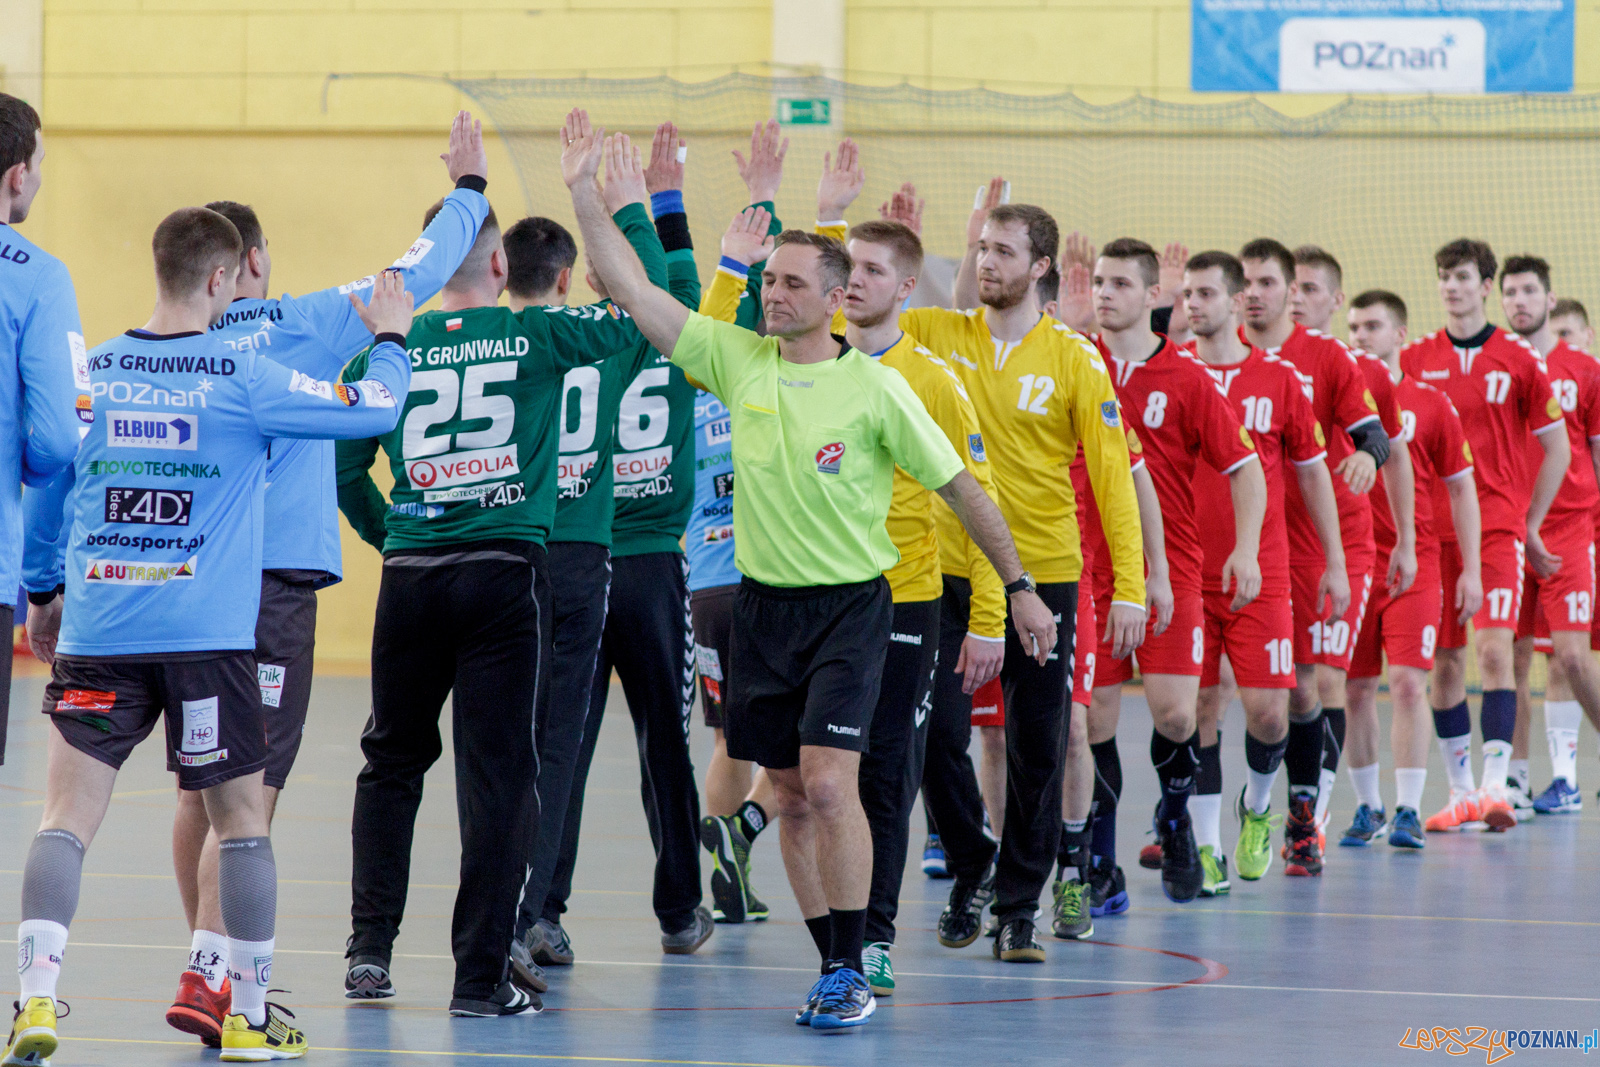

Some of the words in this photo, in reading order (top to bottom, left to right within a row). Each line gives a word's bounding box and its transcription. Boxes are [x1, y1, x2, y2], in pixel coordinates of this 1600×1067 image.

[0, 242, 30, 264] LD
[119, 354, 235, 376] GRUNWALD
[426, 336, 530, 366] GRUNWALD
[1018, 373, 1055, 416] 12
[1485, 370, 1512, 404] 17
[1551, 378, 1578, 412] 13
[81, 411, 93, 420] UNO
[402, 360, 519, 459] 25
[1143, 390, 1168, 429] 8
[1241, 395, 1273, 434] 10
[114, 419, 168, 439] ELBUD
[440, 454, 514, 479] VEOLIA
[613, 455, 669, 476] EOLIA
[493, 484, 522, 506] 4D
[644, 476, 670, 496] 4D
[110, 490, 121, 520] idea
[130, 491, 184, 523] 4D
[87, 533, 205, 552] bodosport.pl
[104, 565, 177, 581] BUTRANS
[1487, 588, 1513, 620] 17
[1565, 591, 1591, 624] 13
[1191, 626, 1204, 664] 8
[1265, 638, 1292, 675] 10
[1421, 625, 1436, 659] 9
[827, 723, 861, 736] hummel
[181, 752, 218, 765] BUTRANS
